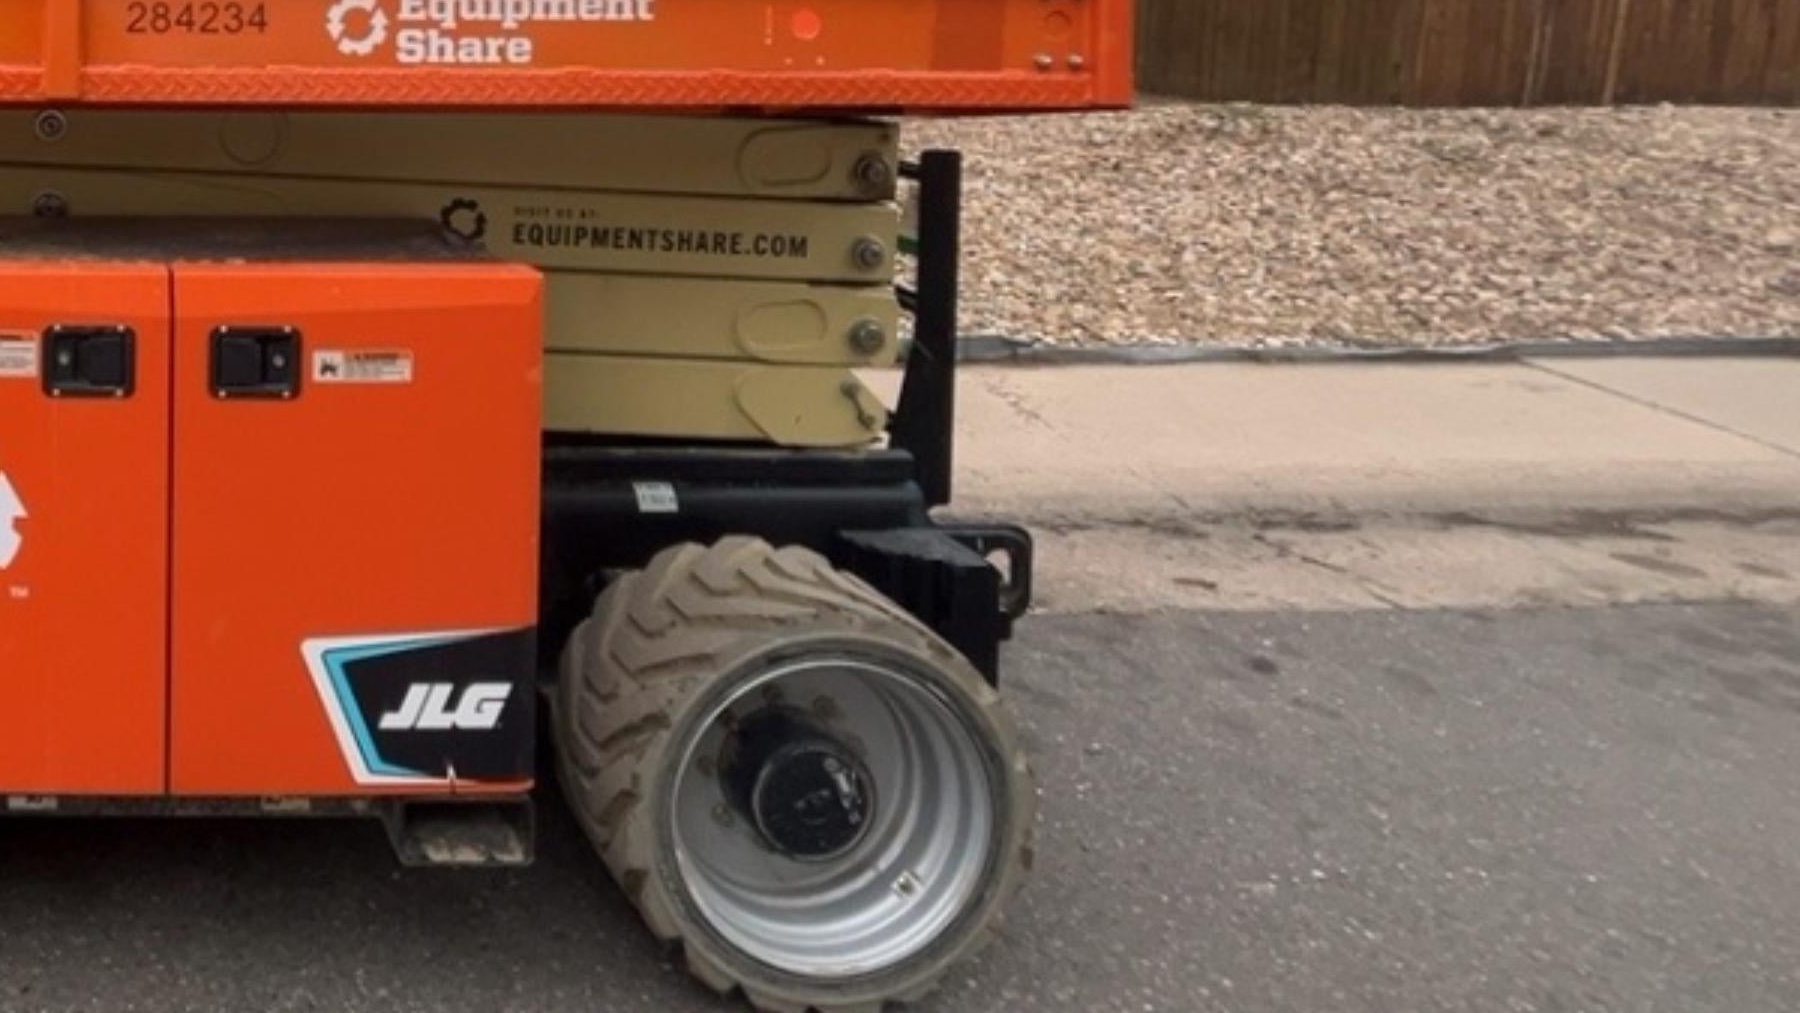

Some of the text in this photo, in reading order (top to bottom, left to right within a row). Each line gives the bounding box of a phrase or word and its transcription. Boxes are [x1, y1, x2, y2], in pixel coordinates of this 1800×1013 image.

[126, 0, 269, 35] 284234
[395, 28, 532, 64] Share
[512, 223, 808, 258] EQUIPMENTSHARE.COM
[378, 682, 513, 729] JLG
